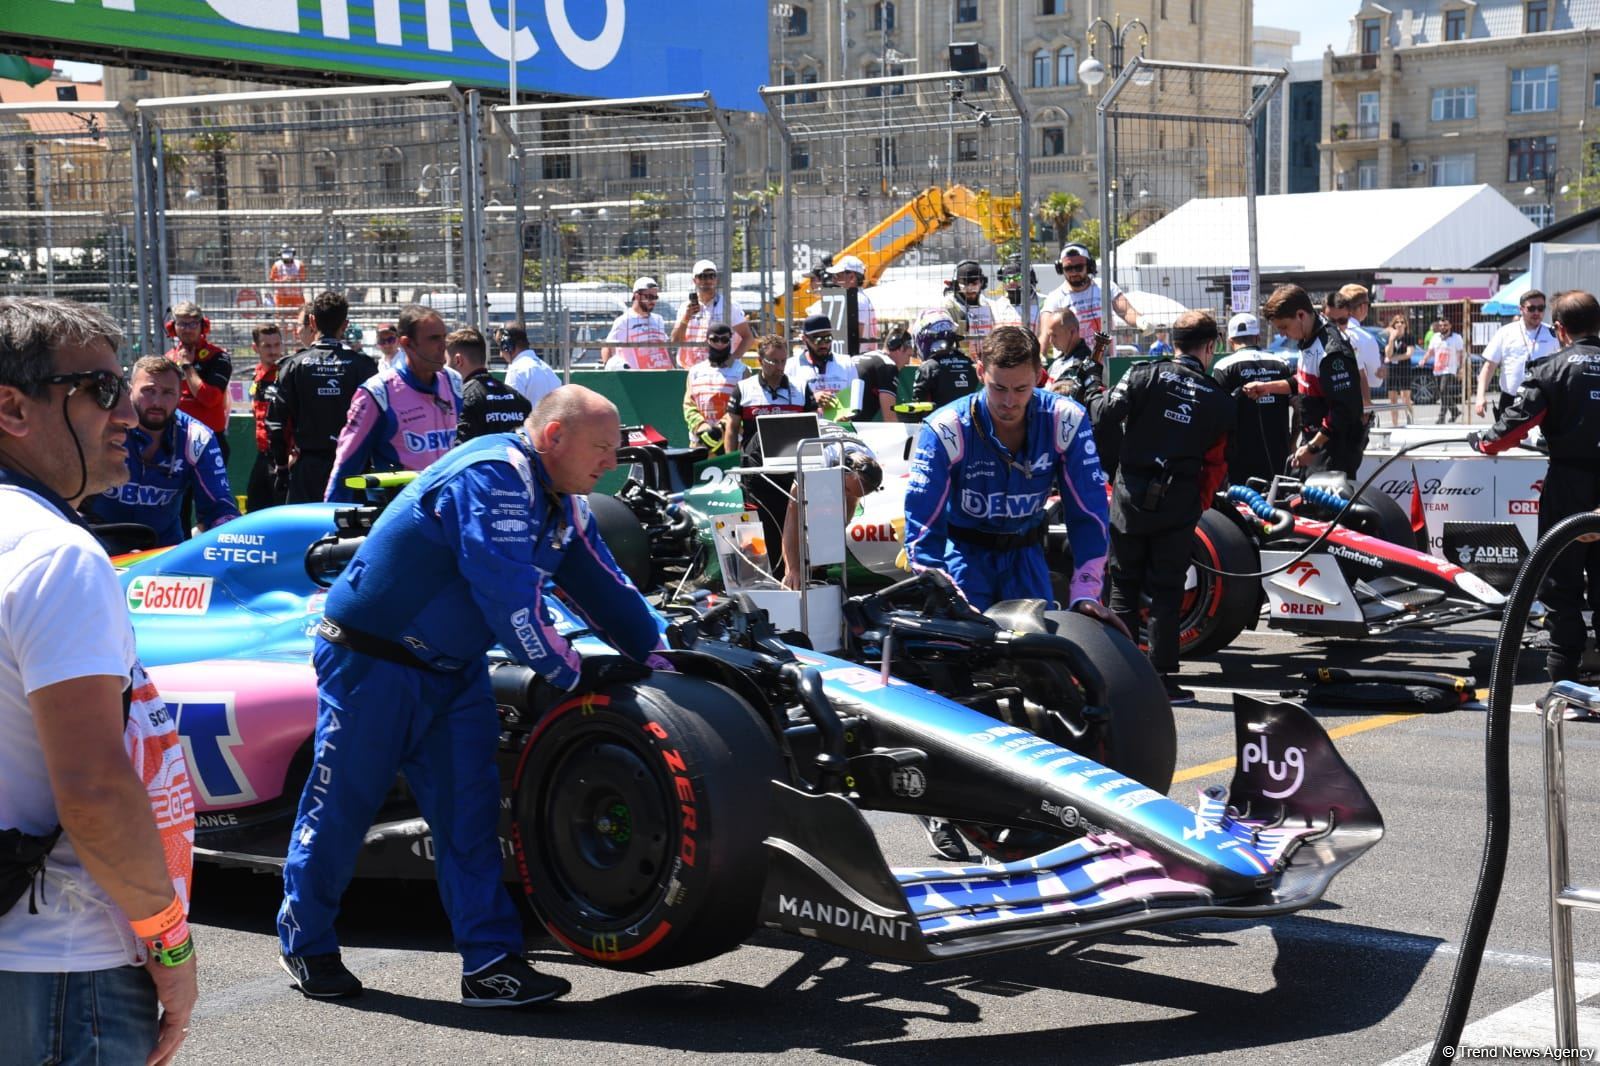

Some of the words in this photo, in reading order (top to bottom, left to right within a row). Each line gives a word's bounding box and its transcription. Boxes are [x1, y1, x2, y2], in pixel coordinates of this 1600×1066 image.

[822, 294, 846, 332] 77
[831, 340, 846, 357] OT
[1159, 370, 1182, 383] Alfa
[485, 412, 525, 423] PETONAS
[1164, 410, 1191, 423] ORLEN
[427, 430, 457, 451] BW
[120, 483, 178, 505] BWT
[1422, 478, 1484, 496] Romeo
[1424, 502, 1449, 512] TEAM
[1510, 502, 1540, 514] ORL
[217, 533, 265, 546] RENAULT
[850, 523, 897, 542] ORLE
[203, 547, 278, 564] E-TECH
[1327, 543, 1384, 569] aximtrade
[1475, 545, 1519, 558] ADLER
[144, 580, 206, 610] Castrol
[1280, 602, 1324, 616] ORLEN
[514, 622, 549, 661] BWT
[1242, 735, 1306, 800] plug
[642, 720, 668, 741] P
[661, 748, 698, 868] ZERO
[1040, 799, 1062, 818] Bell
[194, 814, 239, 827] ANCE
[778, 893, 913, 941] MANDIANT
